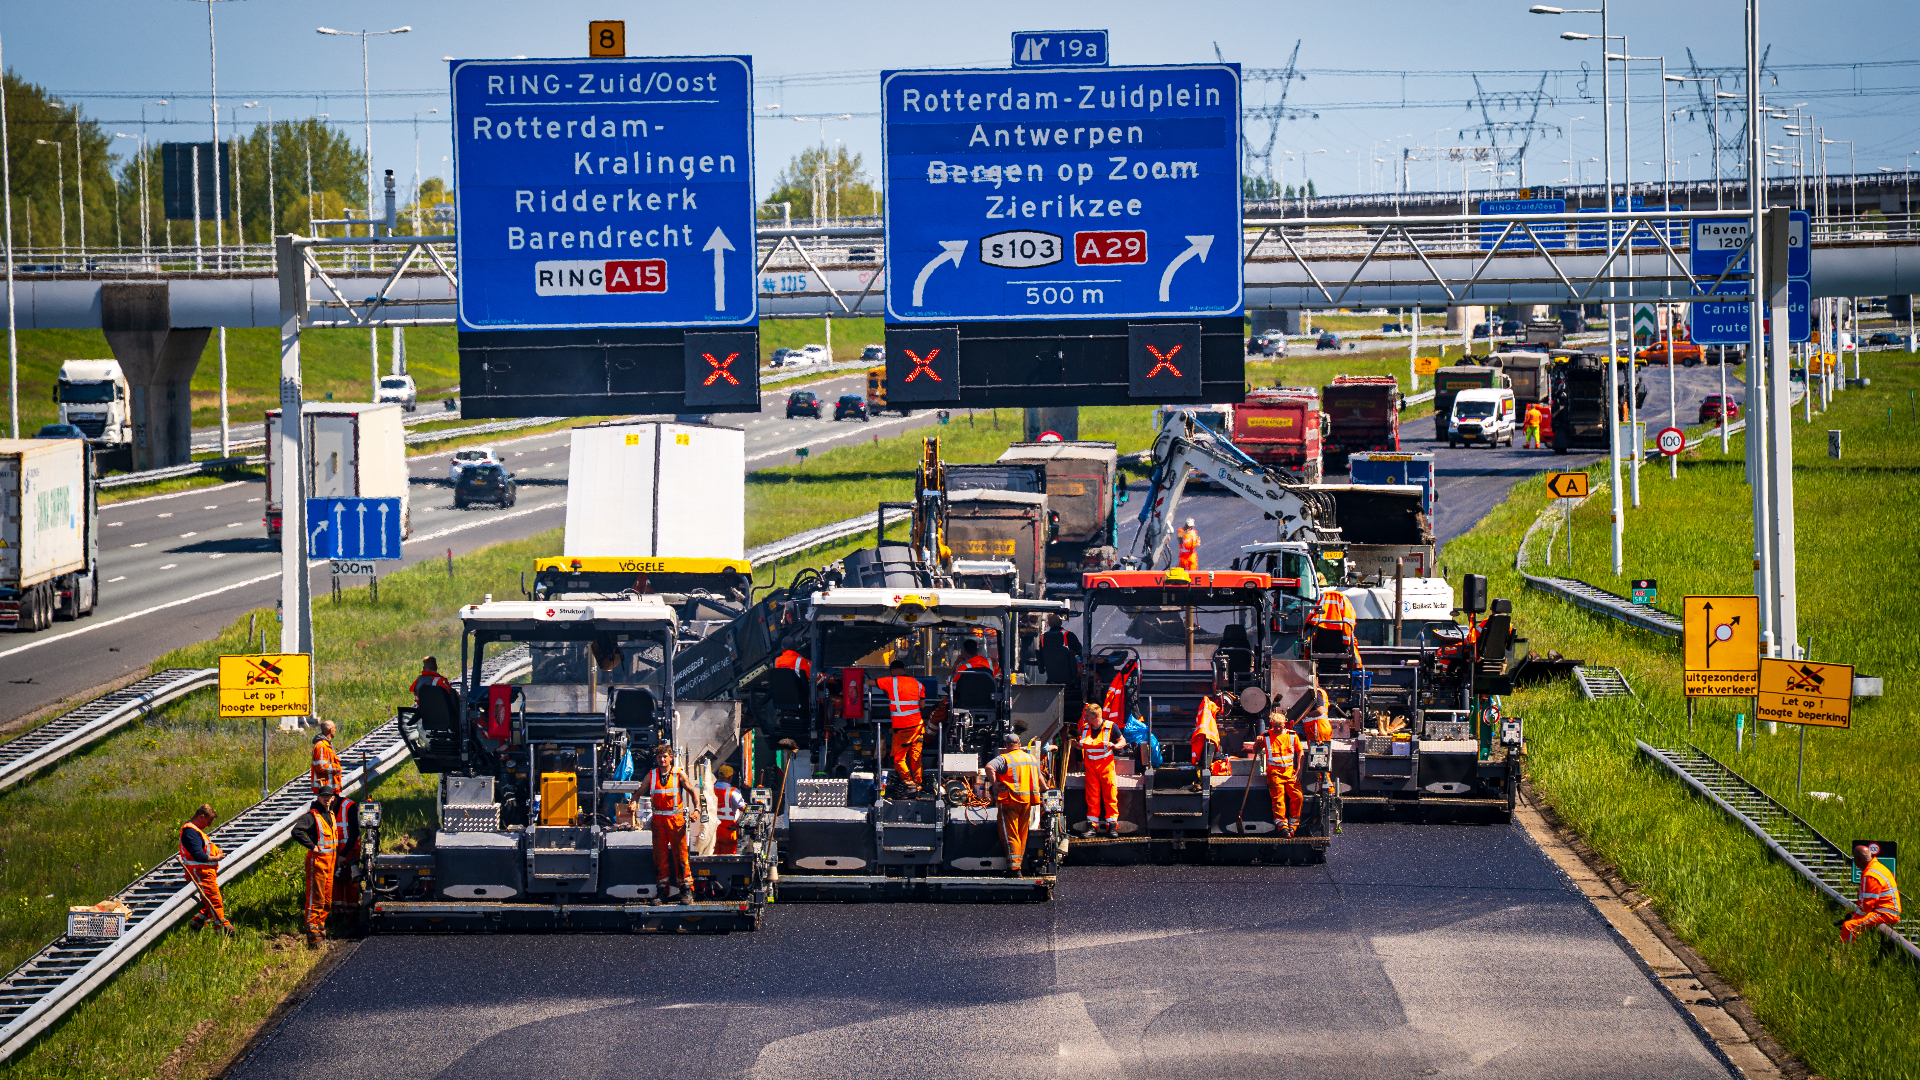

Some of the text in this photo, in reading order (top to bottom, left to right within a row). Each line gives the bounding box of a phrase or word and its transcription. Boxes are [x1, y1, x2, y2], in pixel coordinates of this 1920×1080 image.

[599, 29, 615, 48] 8
[1059, 39, 1098, 58] 19a
[488, 72, 717, 95] RING-Zuid/Oost
[903, 83, 1220, 112] Rotterdam-Zuidplein
[473, 115, 665, 140] Rotterdam-
[969, 123, 1143, 149] Antwerpen
[574, 151, 736, 181] Kralingen
[927, 156, 1200, 190] Bergen op Zoom
[515, 188, 698, 213] Ridderkerk
[985, 194, 1142, 219] Zierikzee
[508, 224, 693, 250] Barendrecht
[1702, 224, 1746, 235] Haven
[991, 239, 1056, 260] s103
[1081, 237, 1142, 259] A29
[539, 266, 662, 288] RING A15
[1026, 287, 1105, 305] 500 m
[1711, 322, 1748, 333] route
[1662, 435, 1681, 447] 100
[1565, 478, 1579, 493] A
[331, 562, 375, 574] 300m
[619, 559, 665, 572] VÖGELE
[1686, 672, 1757, 684] uitgezonderd
[244, 691, 259, 700] Let
[264, 692, 276, 701] op
[1687, 684, 1756, 695] werkverkeer
[221, 701, 308, 714] hoogte beperking
[1782, 696, 1799, 706] Let
[1803, 699, 1815, 709] op
[1758, 705, 1848, 725] hoogte beperking
